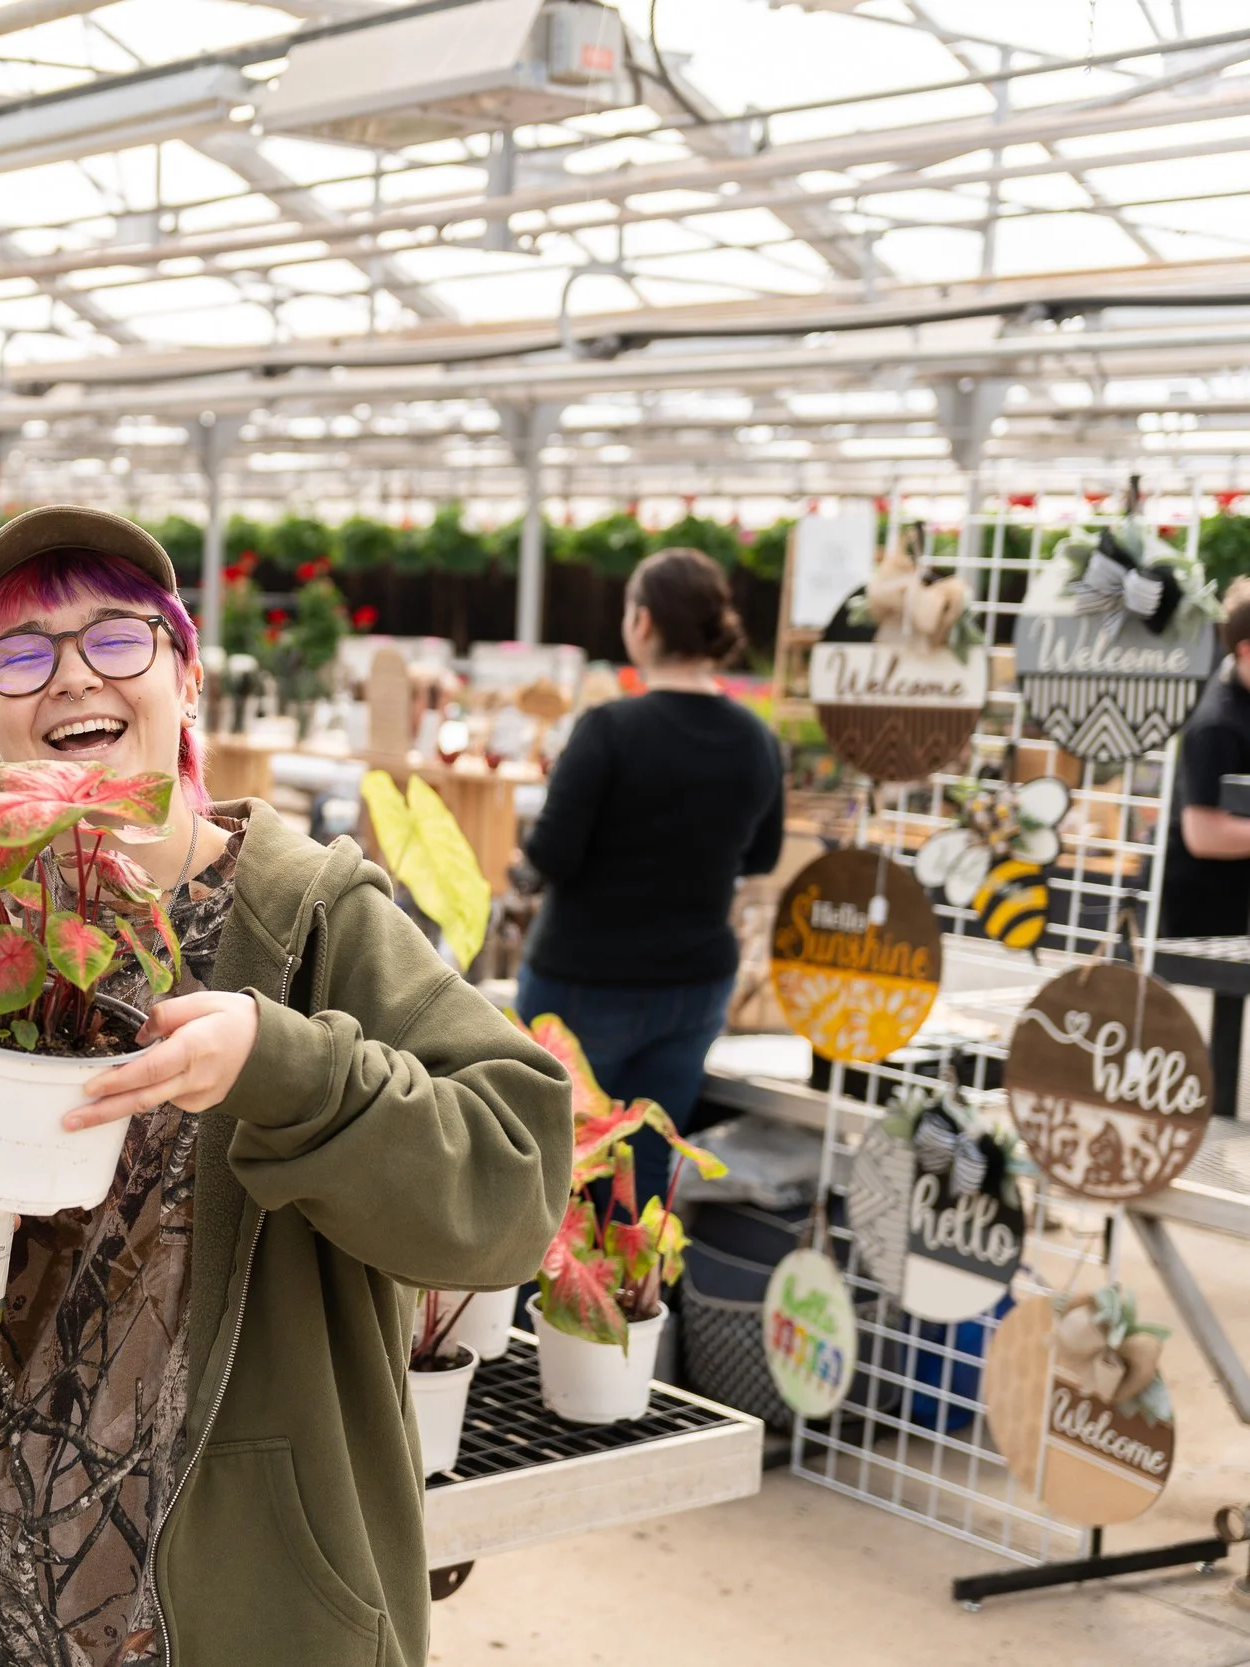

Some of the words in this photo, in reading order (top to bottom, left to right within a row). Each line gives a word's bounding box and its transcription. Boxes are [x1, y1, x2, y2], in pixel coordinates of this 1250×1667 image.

[827, 646, 966, 696] Welcome
[1028, 615, 1190, 673] Welcome
[778, 885, 929, 977] Sunshine
[1092, 1021, 1207, 1115] hello
[911, 1173, 1019, 1266] hello
[1053, 1387, 1168, 1474] Welcome
